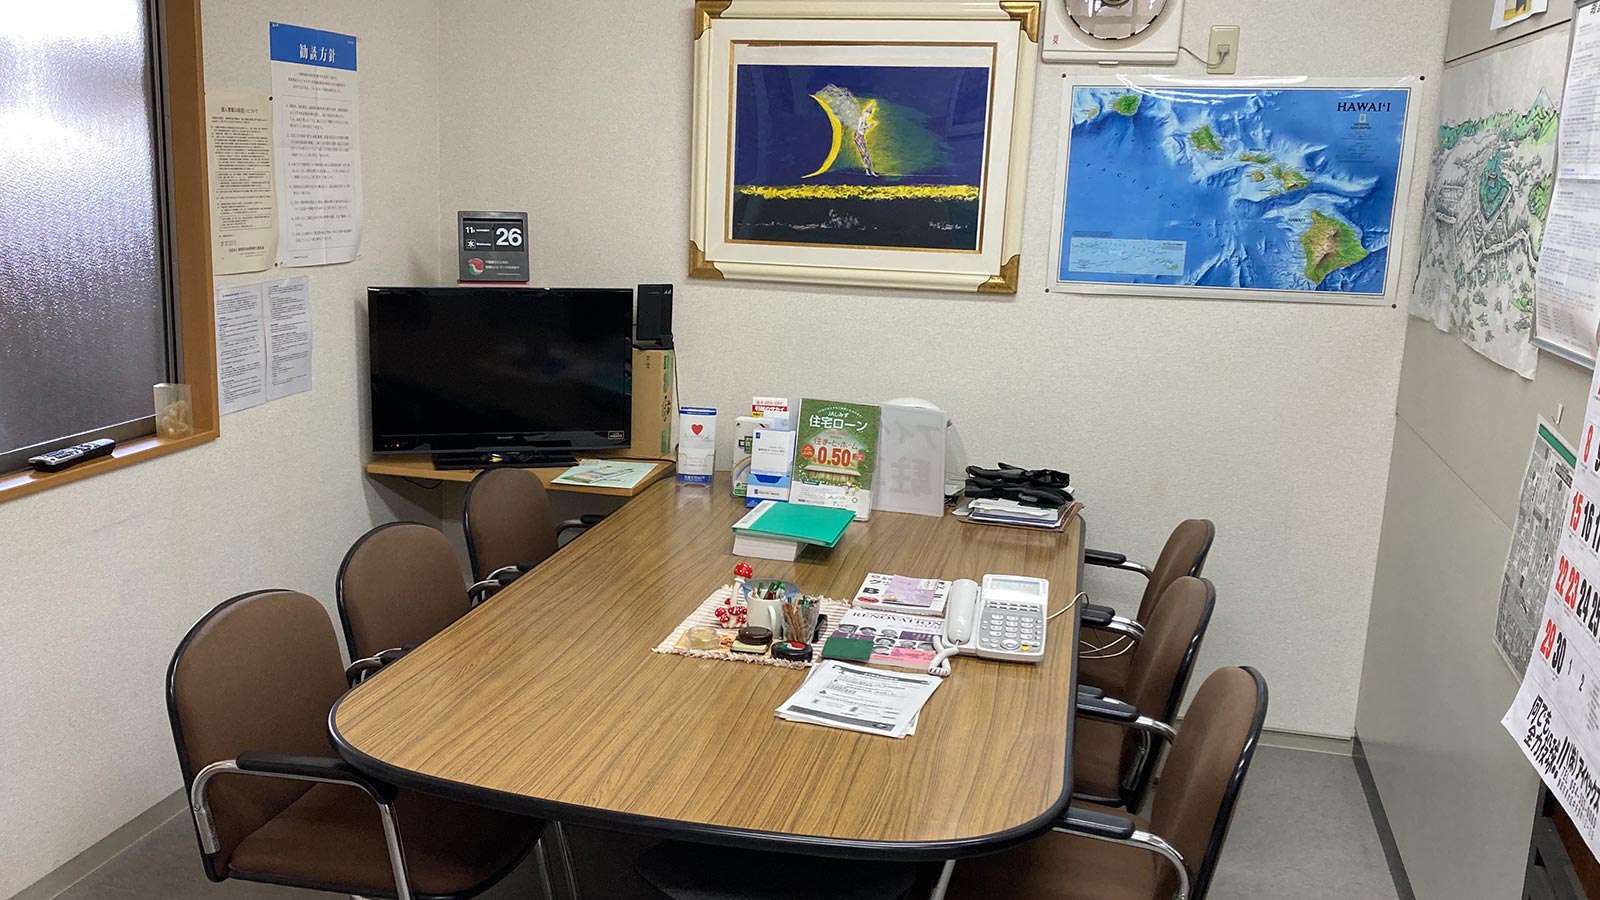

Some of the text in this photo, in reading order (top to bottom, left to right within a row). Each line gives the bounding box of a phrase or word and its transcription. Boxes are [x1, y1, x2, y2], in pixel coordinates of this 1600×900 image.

[299, 43, 336, 63] 勧誘方針
[495, 227, 523, 247] 26
[809, 414, 868, 432] 住宅ローン
[1584, 425, 1594, 463] 8
[817, 446, 851, 467] 0.50
[1570, 491, 1584, 532] 15
[1581, 500, 1595, 543] 16
[1555, 555, 1569, 597] 22
[1564, 566, 1580, 610] 23
[1576, 578, 1592, 624] 24
[852, 612, 944, 627] RENOVATION
[1540, 618, 1557, 660] 29
[1551, 631, 1567, 675] 30
